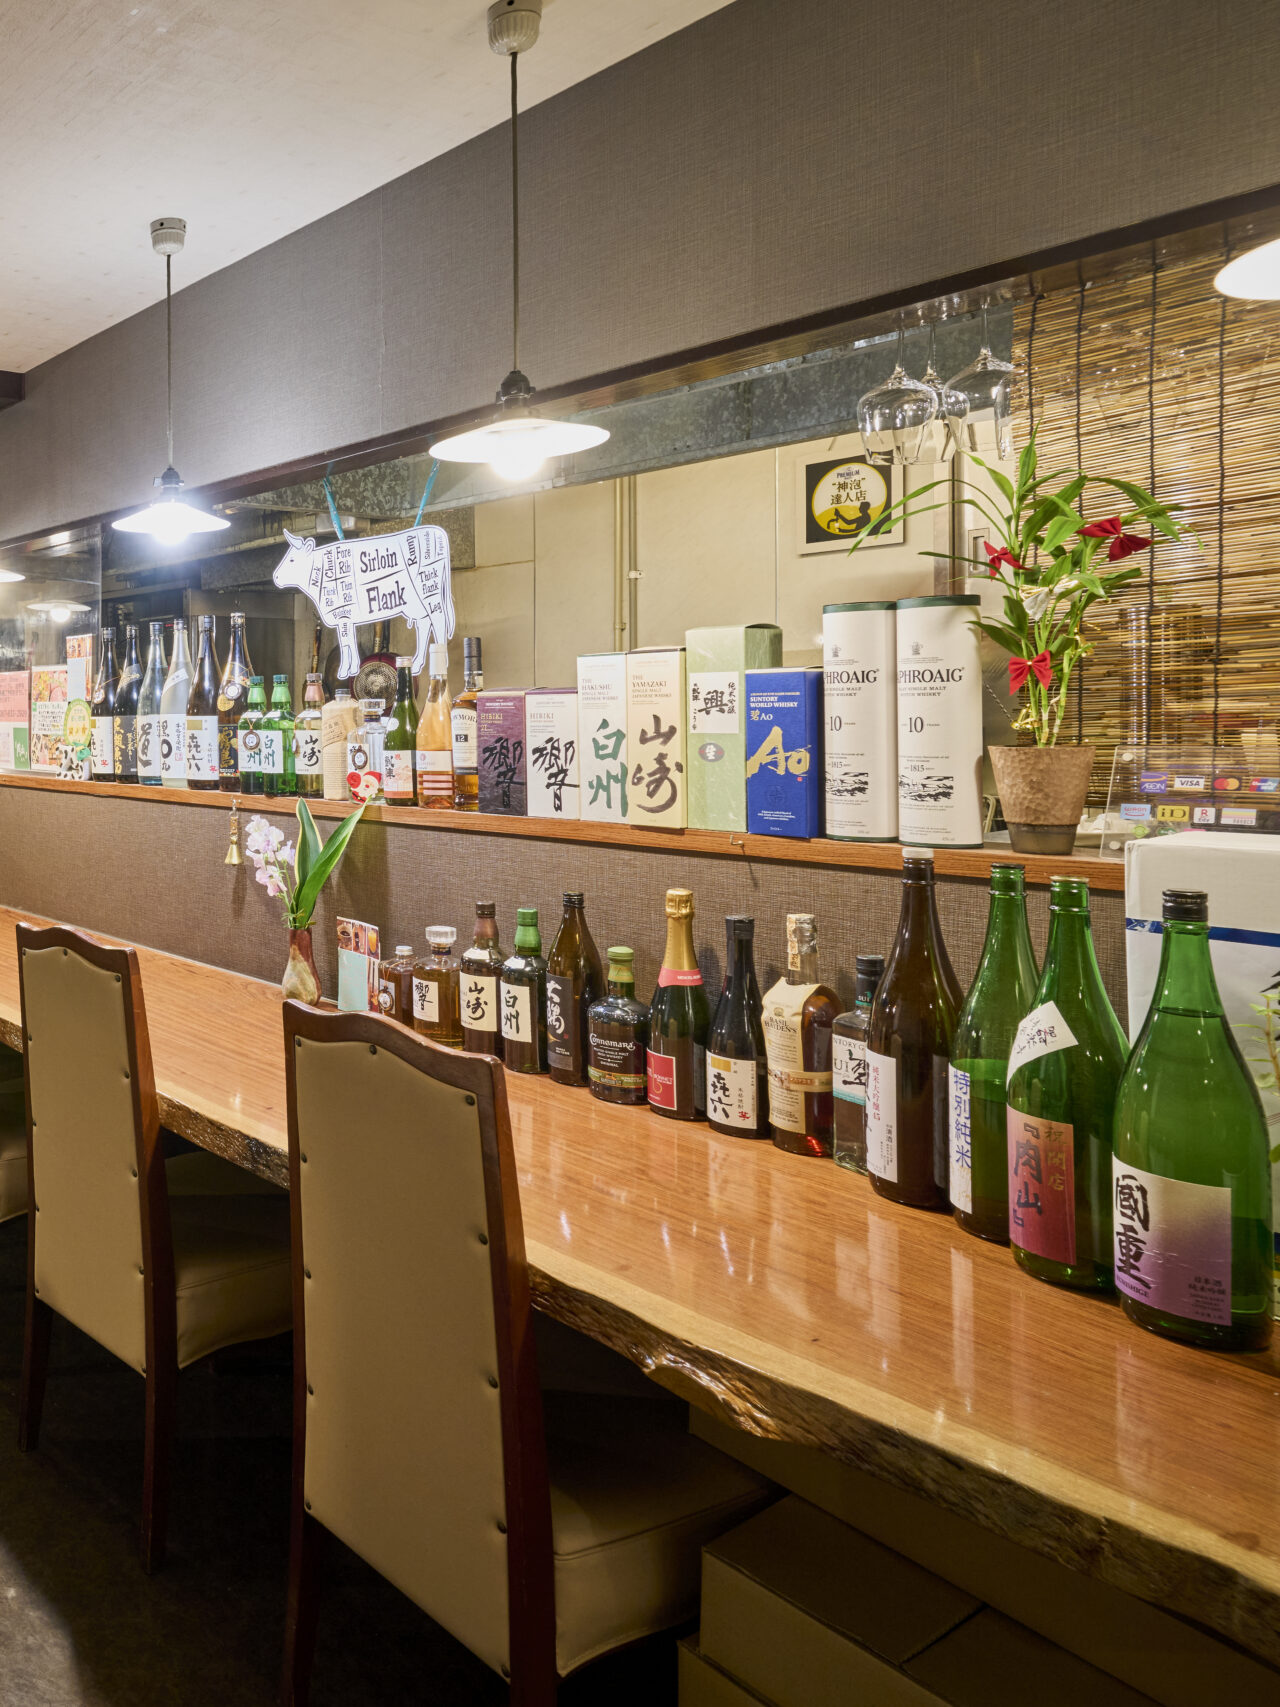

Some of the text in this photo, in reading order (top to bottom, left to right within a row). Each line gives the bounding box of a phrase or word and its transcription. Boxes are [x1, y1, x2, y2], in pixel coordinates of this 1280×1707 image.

[830, 490, 867, 505] 達人店
[336, 546, 352, 560] Fore
[359, 548, 399, 573] Sirloin
[407, 535, 418, 567] Rump
[325, 549, 335, 578] Chuck
[339, 561, 352, 575] Rib
[312, 566, 322, 587] Neck
[418, 567, 439, 583] Thick
[343, 592, 353, 603] Rib
[366, 580, 407, 614] Flank
[428, 601, 443, 615] Leg
[898, 668, 963, 684] PHROAIG
[698, 690, 729, 715] 興
[829, 715, 842, 731] 10
[908, 716, 924, 733] 10
[457, 734, 465, 742] 12
[263, 734, 276, 768] 白州
[303, 735, 322, 767] 山崎
[588, 718, 629, 817] 白州
[632, 714, 684, 814] 山崎
[910, 764, 924, 772] 1815
[466, 981, 488, 1021] 山崎
[504, 989, 520, 1034] 白州
[769, 1017, 787, 1026] BASIL
[590, 1033, 636, 1051] Connemara
[954, 1070, 971, 1168] 特別純米
[1116, 1174, 1152, 1290] 國重
